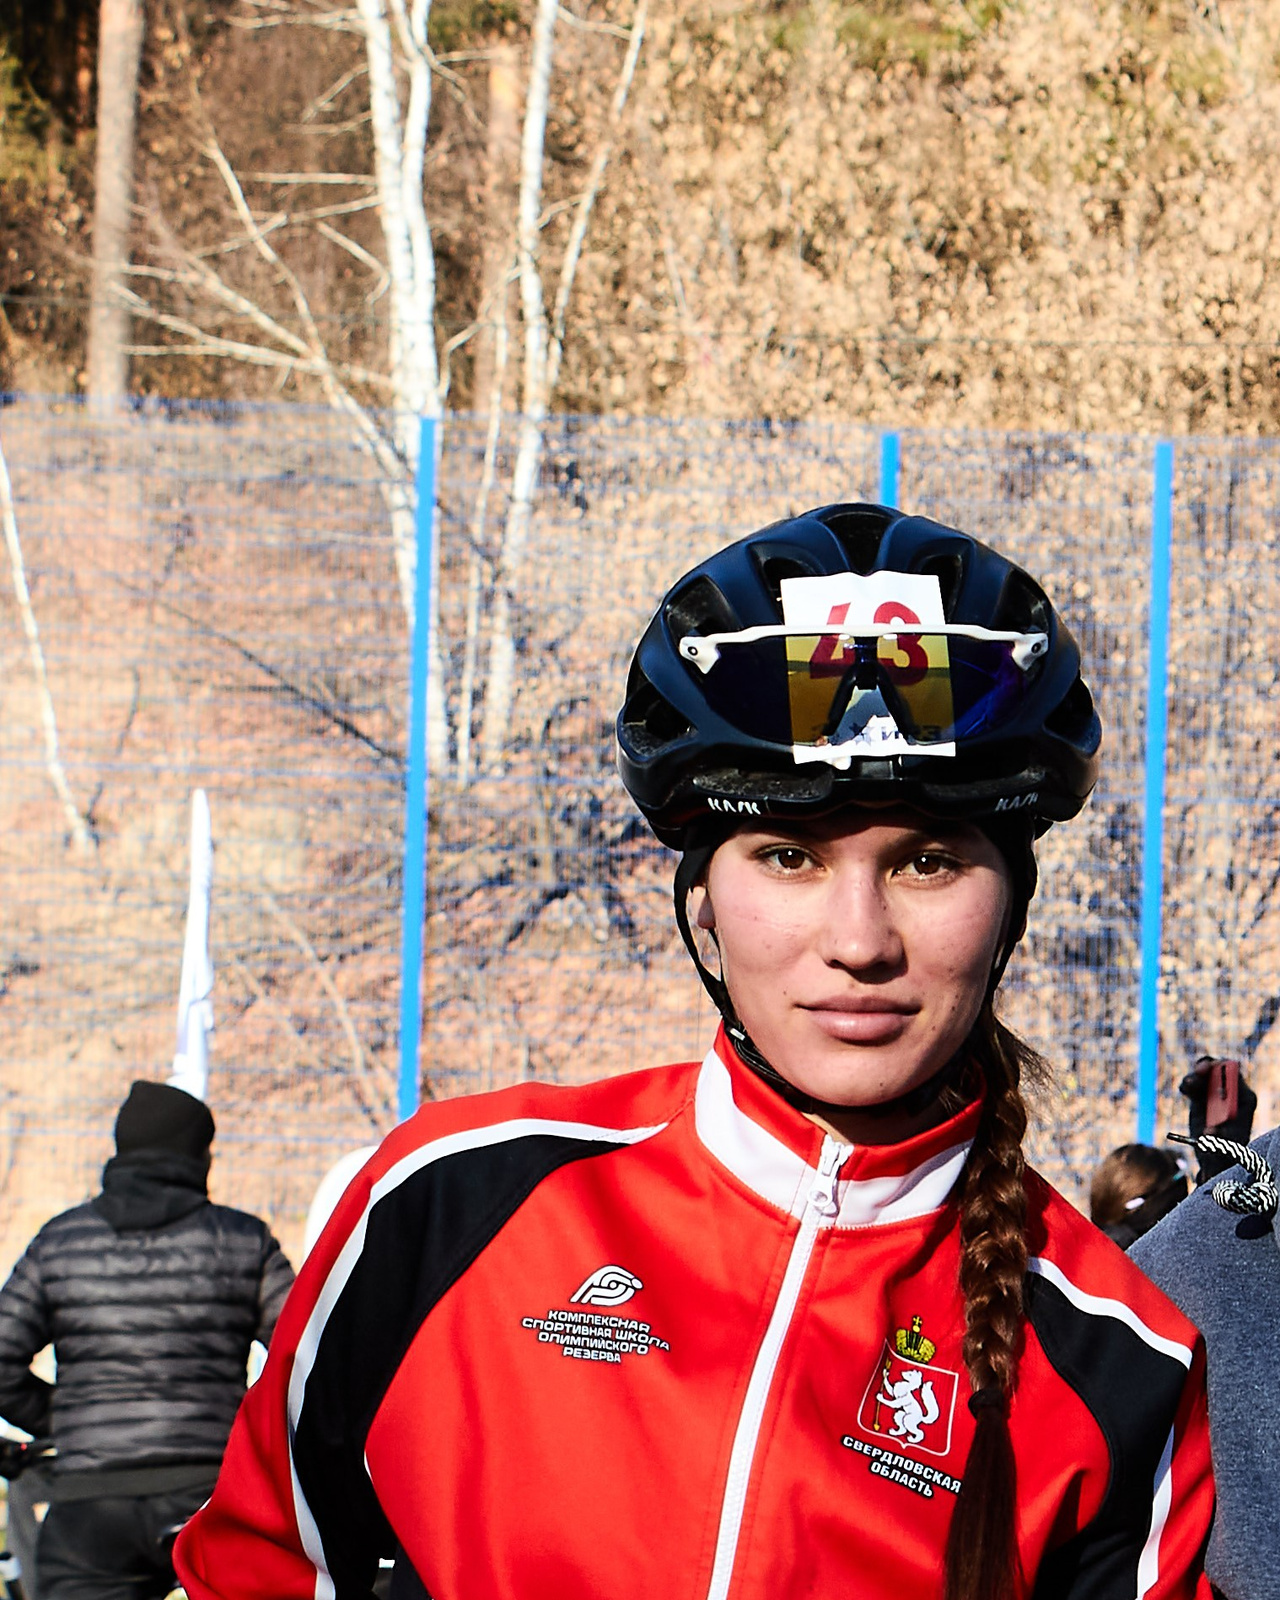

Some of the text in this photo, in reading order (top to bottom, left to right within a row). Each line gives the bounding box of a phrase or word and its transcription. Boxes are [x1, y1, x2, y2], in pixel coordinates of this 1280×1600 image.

[809, 601, 929, 686] 43
[522, 1317, 670, 1351] СПОРТИВНАЯ ШКОЛА
[548, 1310, 650, 1333] КОМПЛЕКСНАЯ
[538, 1331, 649, 1355] ОЛИМПИЙСКОГО
[563, 1347, 621, 1363] РЕЗЕРВА
[842, 1436, 962, 1493] СВЕРДЛОВСКАЯ
[870, 1462, 933, 1497] ОБЛАСТЬ
